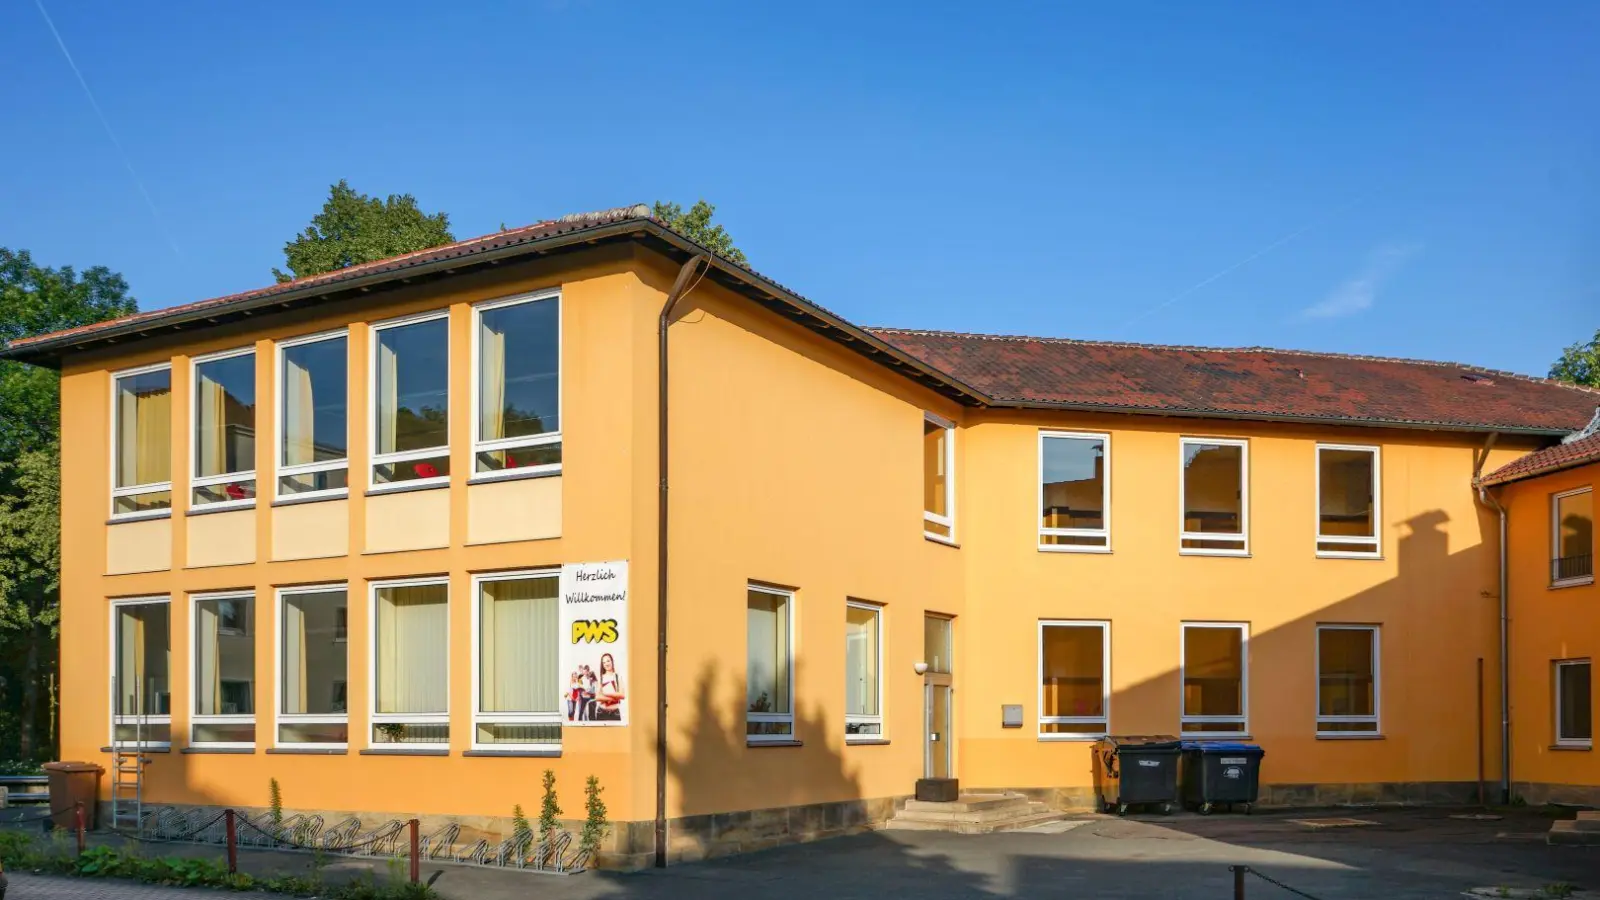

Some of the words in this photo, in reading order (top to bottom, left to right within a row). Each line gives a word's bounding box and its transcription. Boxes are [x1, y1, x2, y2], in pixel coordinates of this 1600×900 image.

[576, 569, 616, 581] Herzlich
[565, 590, 626, 604] Willkommen!
[572, 618, 619, 644] PWS
